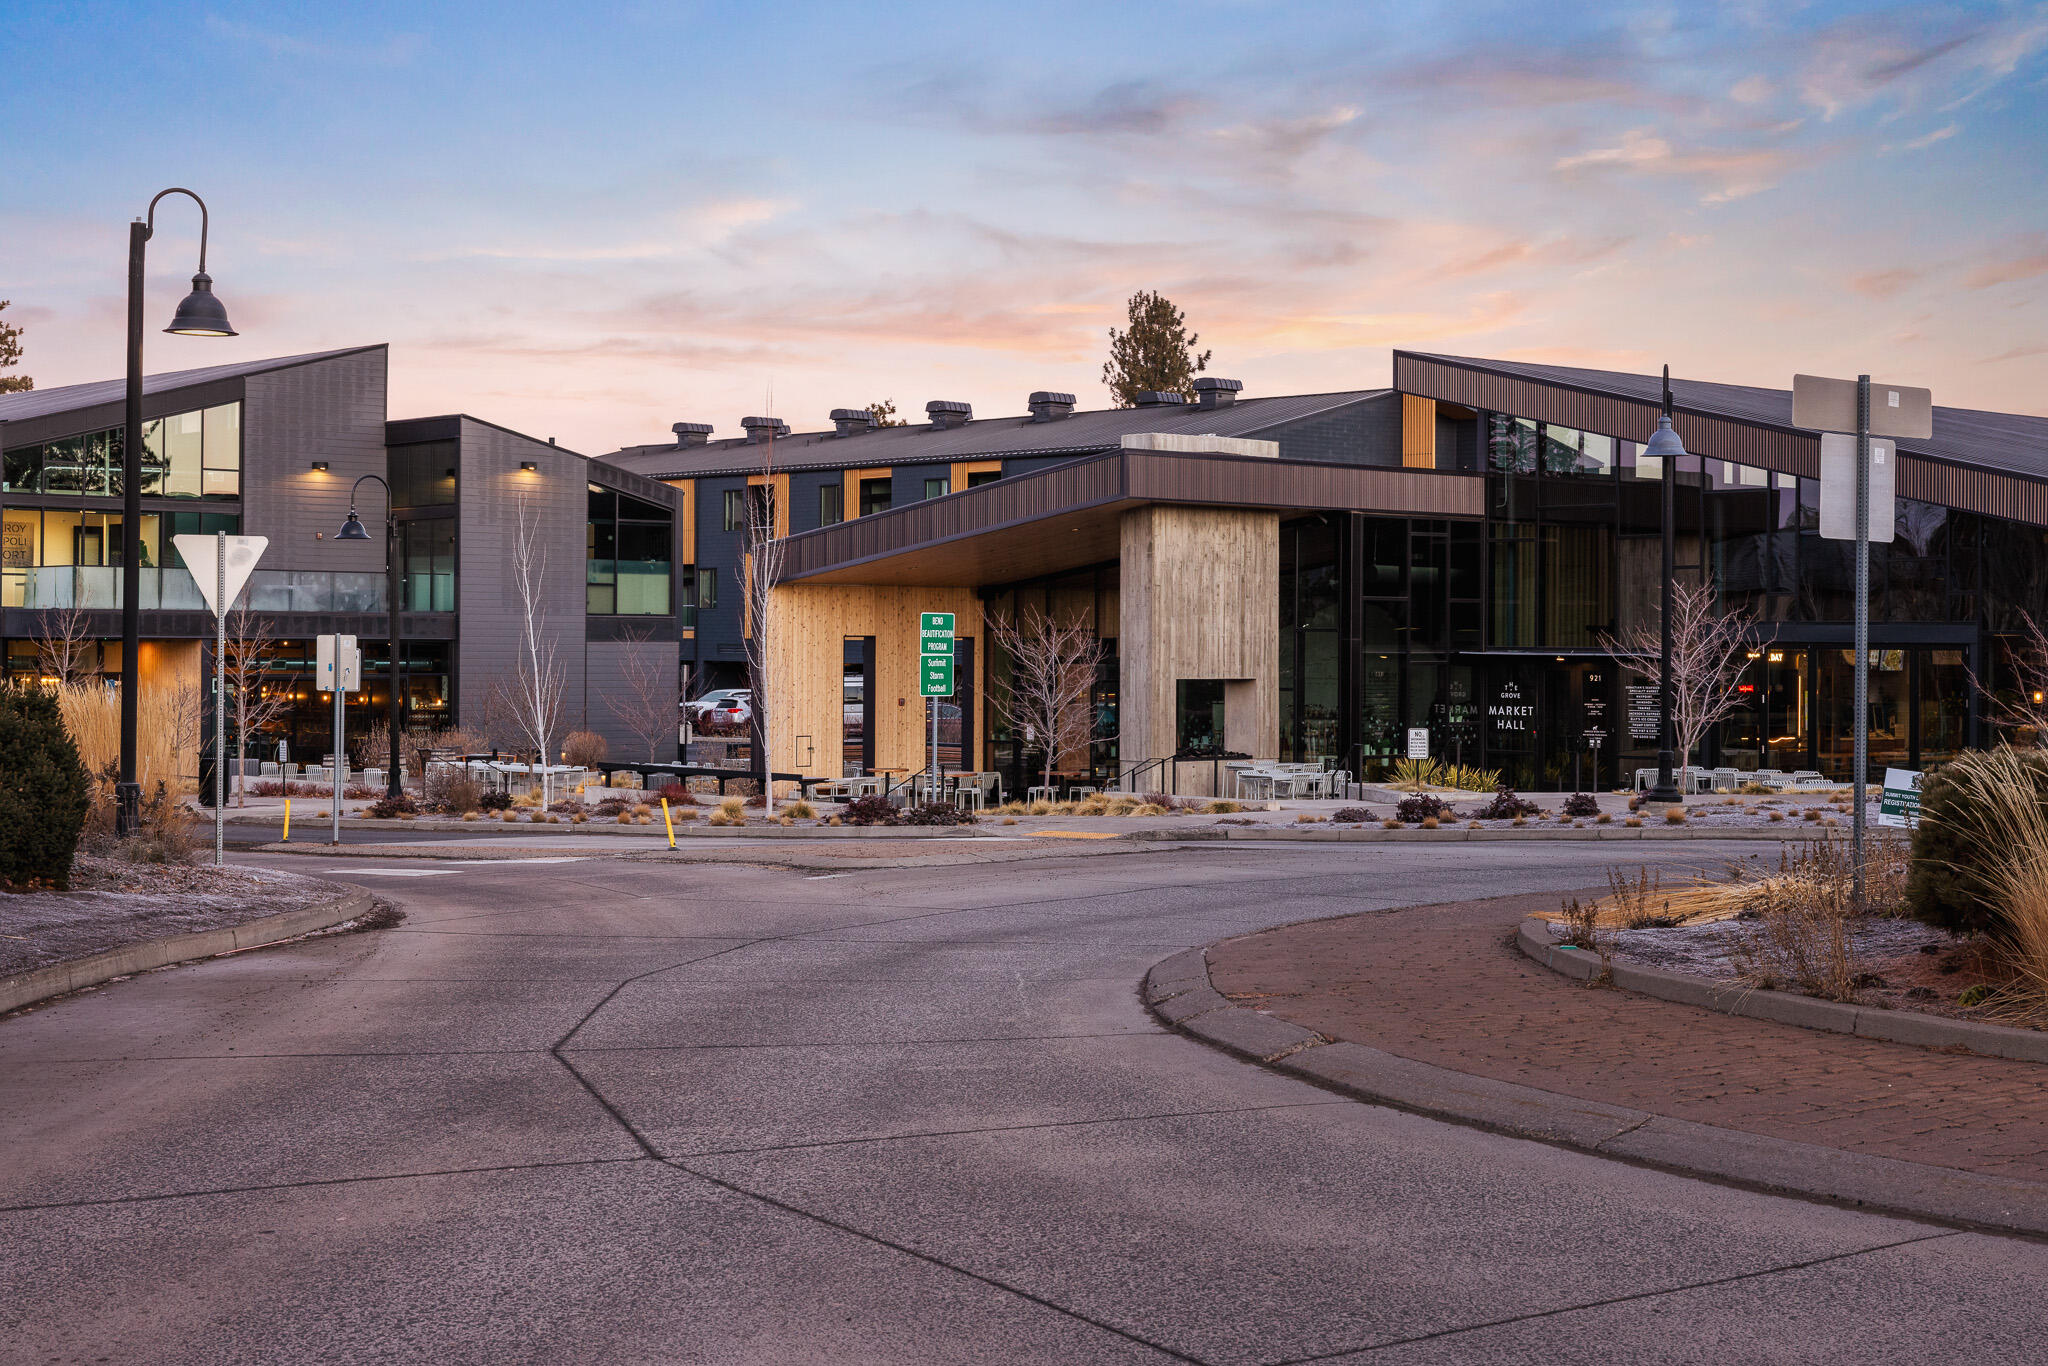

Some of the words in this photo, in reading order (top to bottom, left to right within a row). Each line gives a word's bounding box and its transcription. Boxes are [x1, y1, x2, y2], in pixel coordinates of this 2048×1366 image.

[932, 617, 943, 625] BEND
[922, 630, 953, 638] BEAUTIFICATION
[928, 658, 946, 666] Summit
[928, 684, 946, 692] Football
[1504, 682, 1518, 691] THE
[1489, 706, 1533, 716] MARKET
[1498, 720, 1525, 730] HALL
